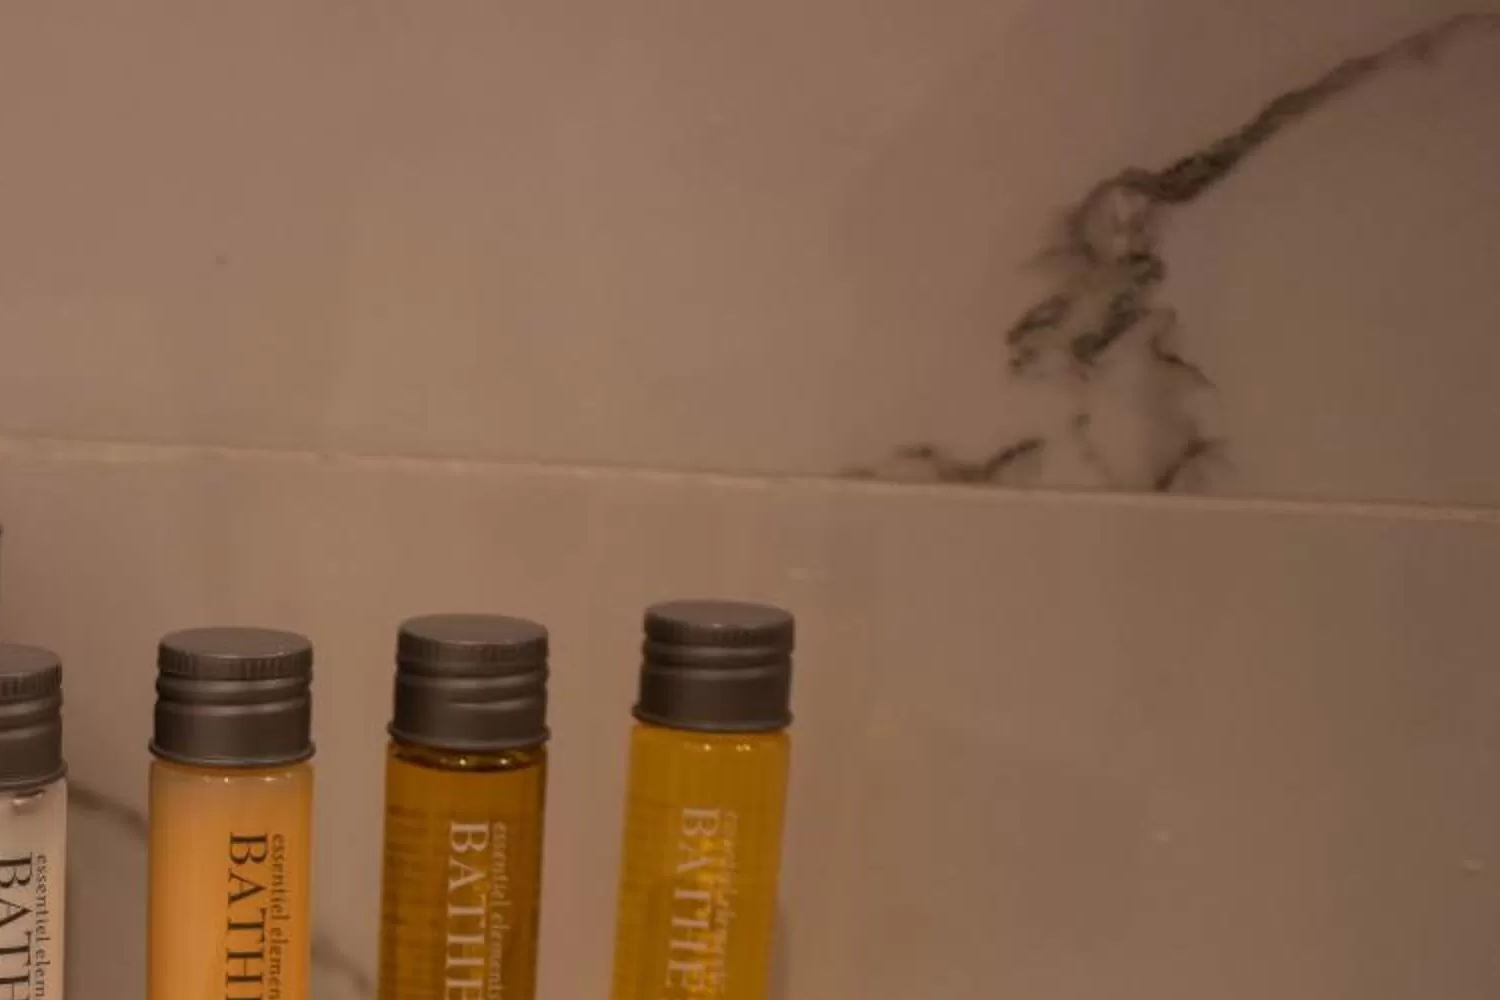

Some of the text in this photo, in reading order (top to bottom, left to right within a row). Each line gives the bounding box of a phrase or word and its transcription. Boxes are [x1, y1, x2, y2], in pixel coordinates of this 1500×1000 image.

[34, 855, 51, 942] essentiel
[270, 834, 290, 920] essentiel
[664, 806, 720, 989] BATHE
